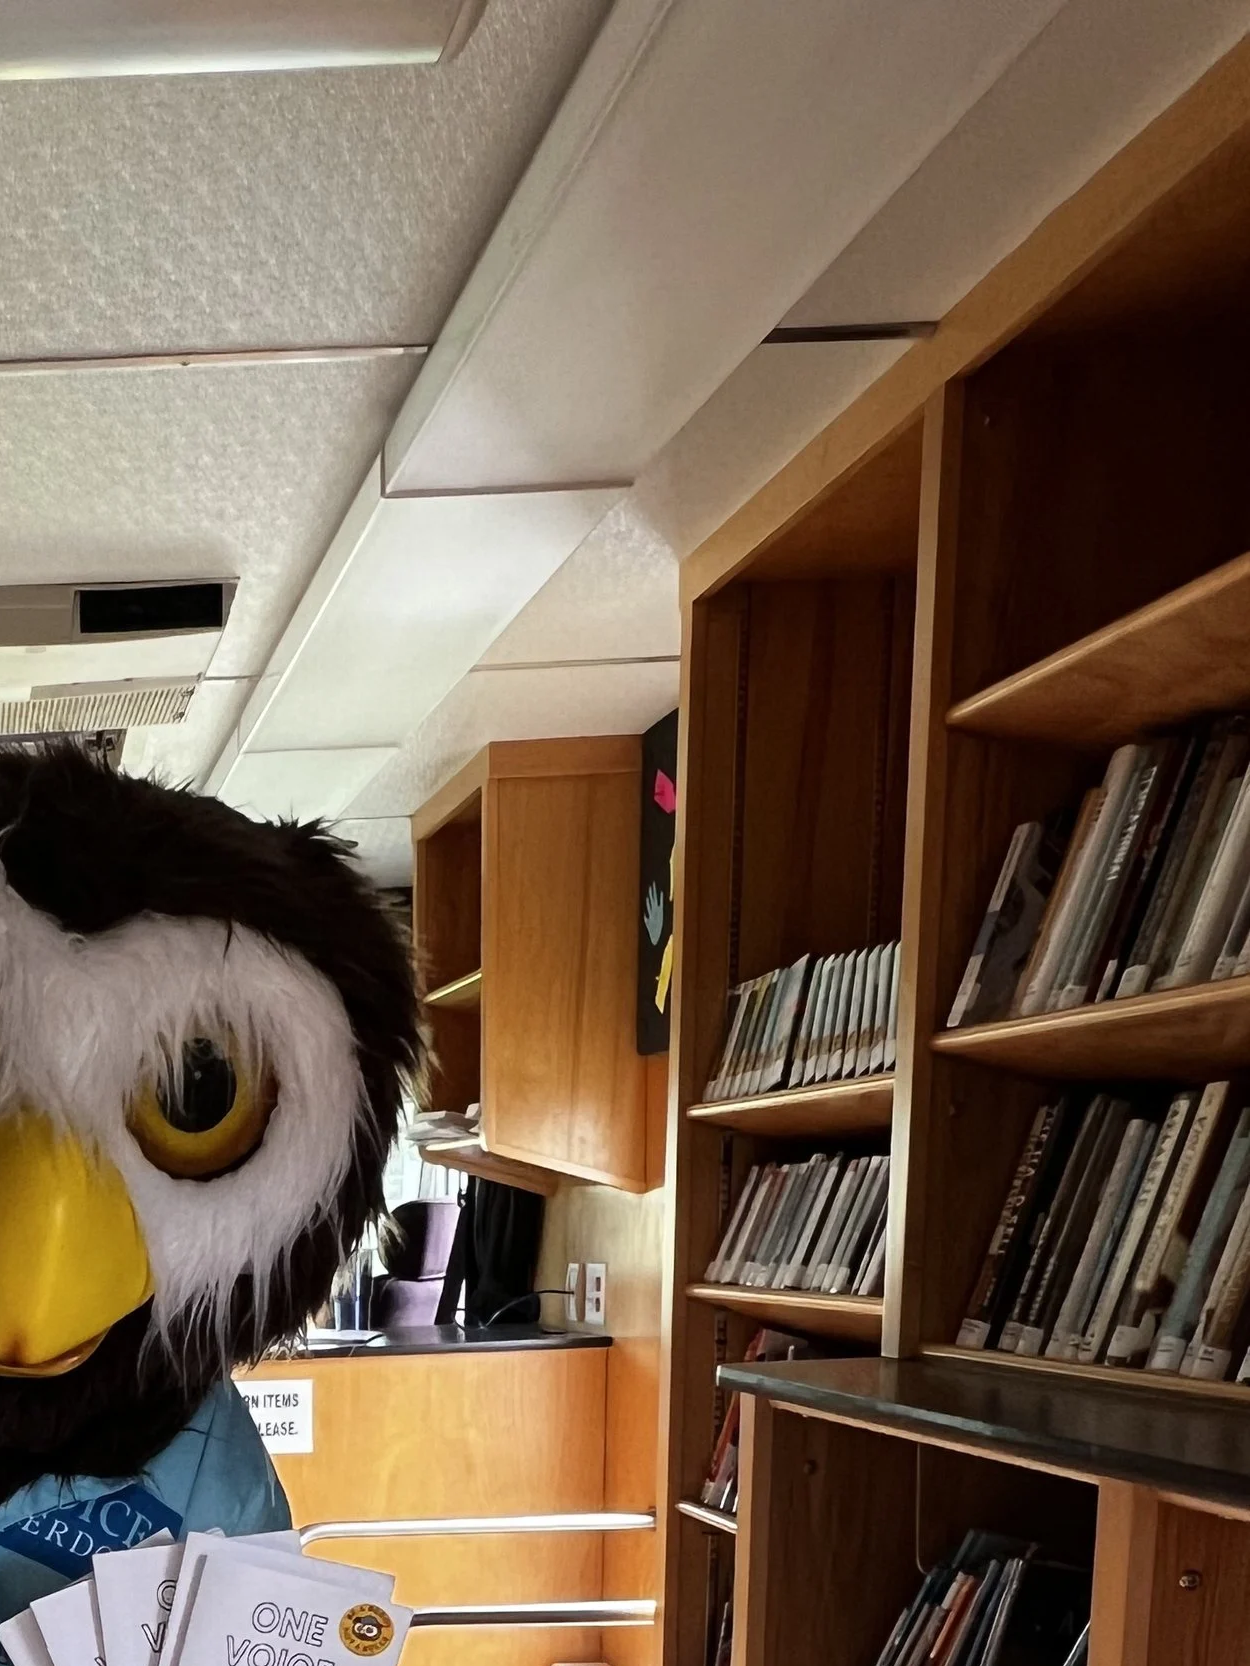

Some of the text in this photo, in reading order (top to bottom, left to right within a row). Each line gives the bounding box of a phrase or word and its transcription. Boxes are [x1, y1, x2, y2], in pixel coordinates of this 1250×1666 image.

[263, 1393, 299, 1409] ITEMS
[257, 1421, 298, 1437] LEASE.
[252, 1601, 329, 1647] ONE
